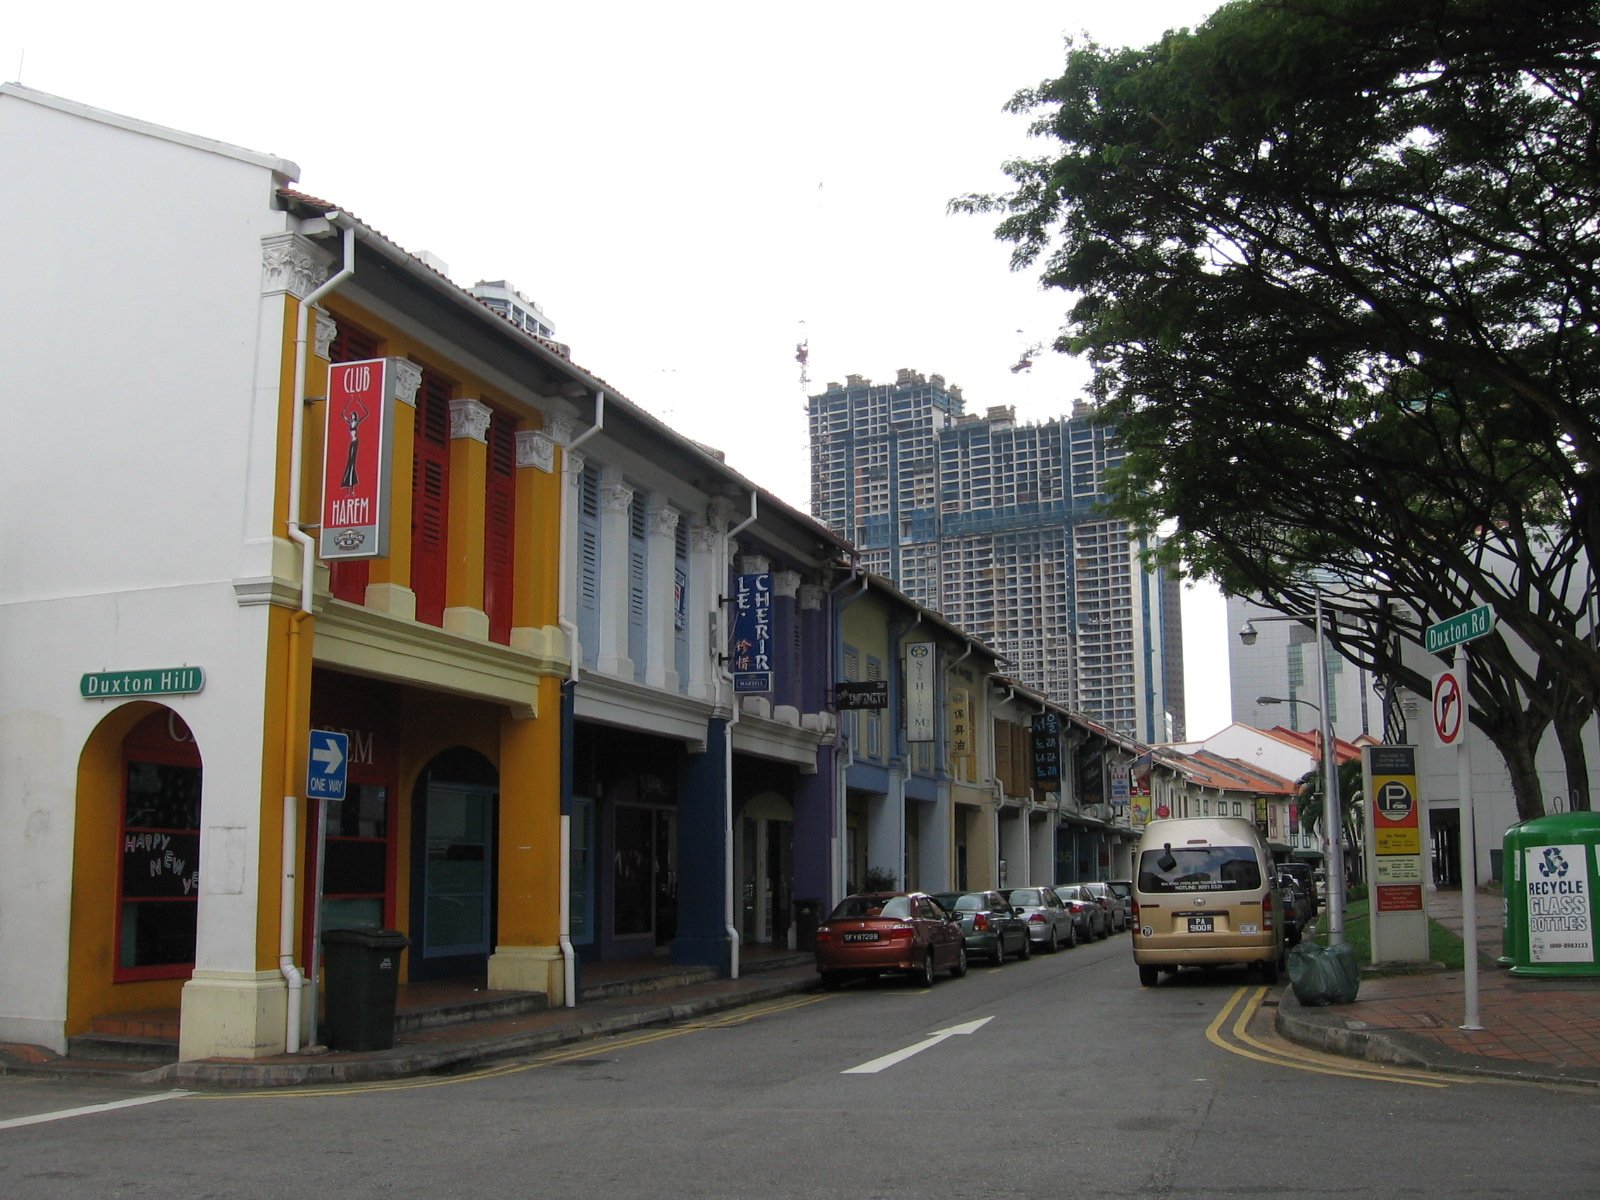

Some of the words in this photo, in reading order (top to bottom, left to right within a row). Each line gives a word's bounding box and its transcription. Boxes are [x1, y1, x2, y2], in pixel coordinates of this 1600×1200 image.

[343, 366, 370, 394] CLUB
[332, 497, 369, 526] HAREM
[1430, 622, 1468, 649] Duxton
[1471, 610, 1485, 633] Rd
[88, 675, 152, 693] Duxton
[161, 670, 193, 690] Hill
[310, 777, 326, 791] ONE
[328, 779, 343, 793] WAY
[1385, 785, 1407, 810] P
[124, 832, 171, 853] HAPPY
[150, 850, 186, 877] NEW
[1529, 880, 1583, 896] RECYCLE
[1530, 895, 1586, 917] GLASS
[1531, 916, 1587, 933] BOTTLES
